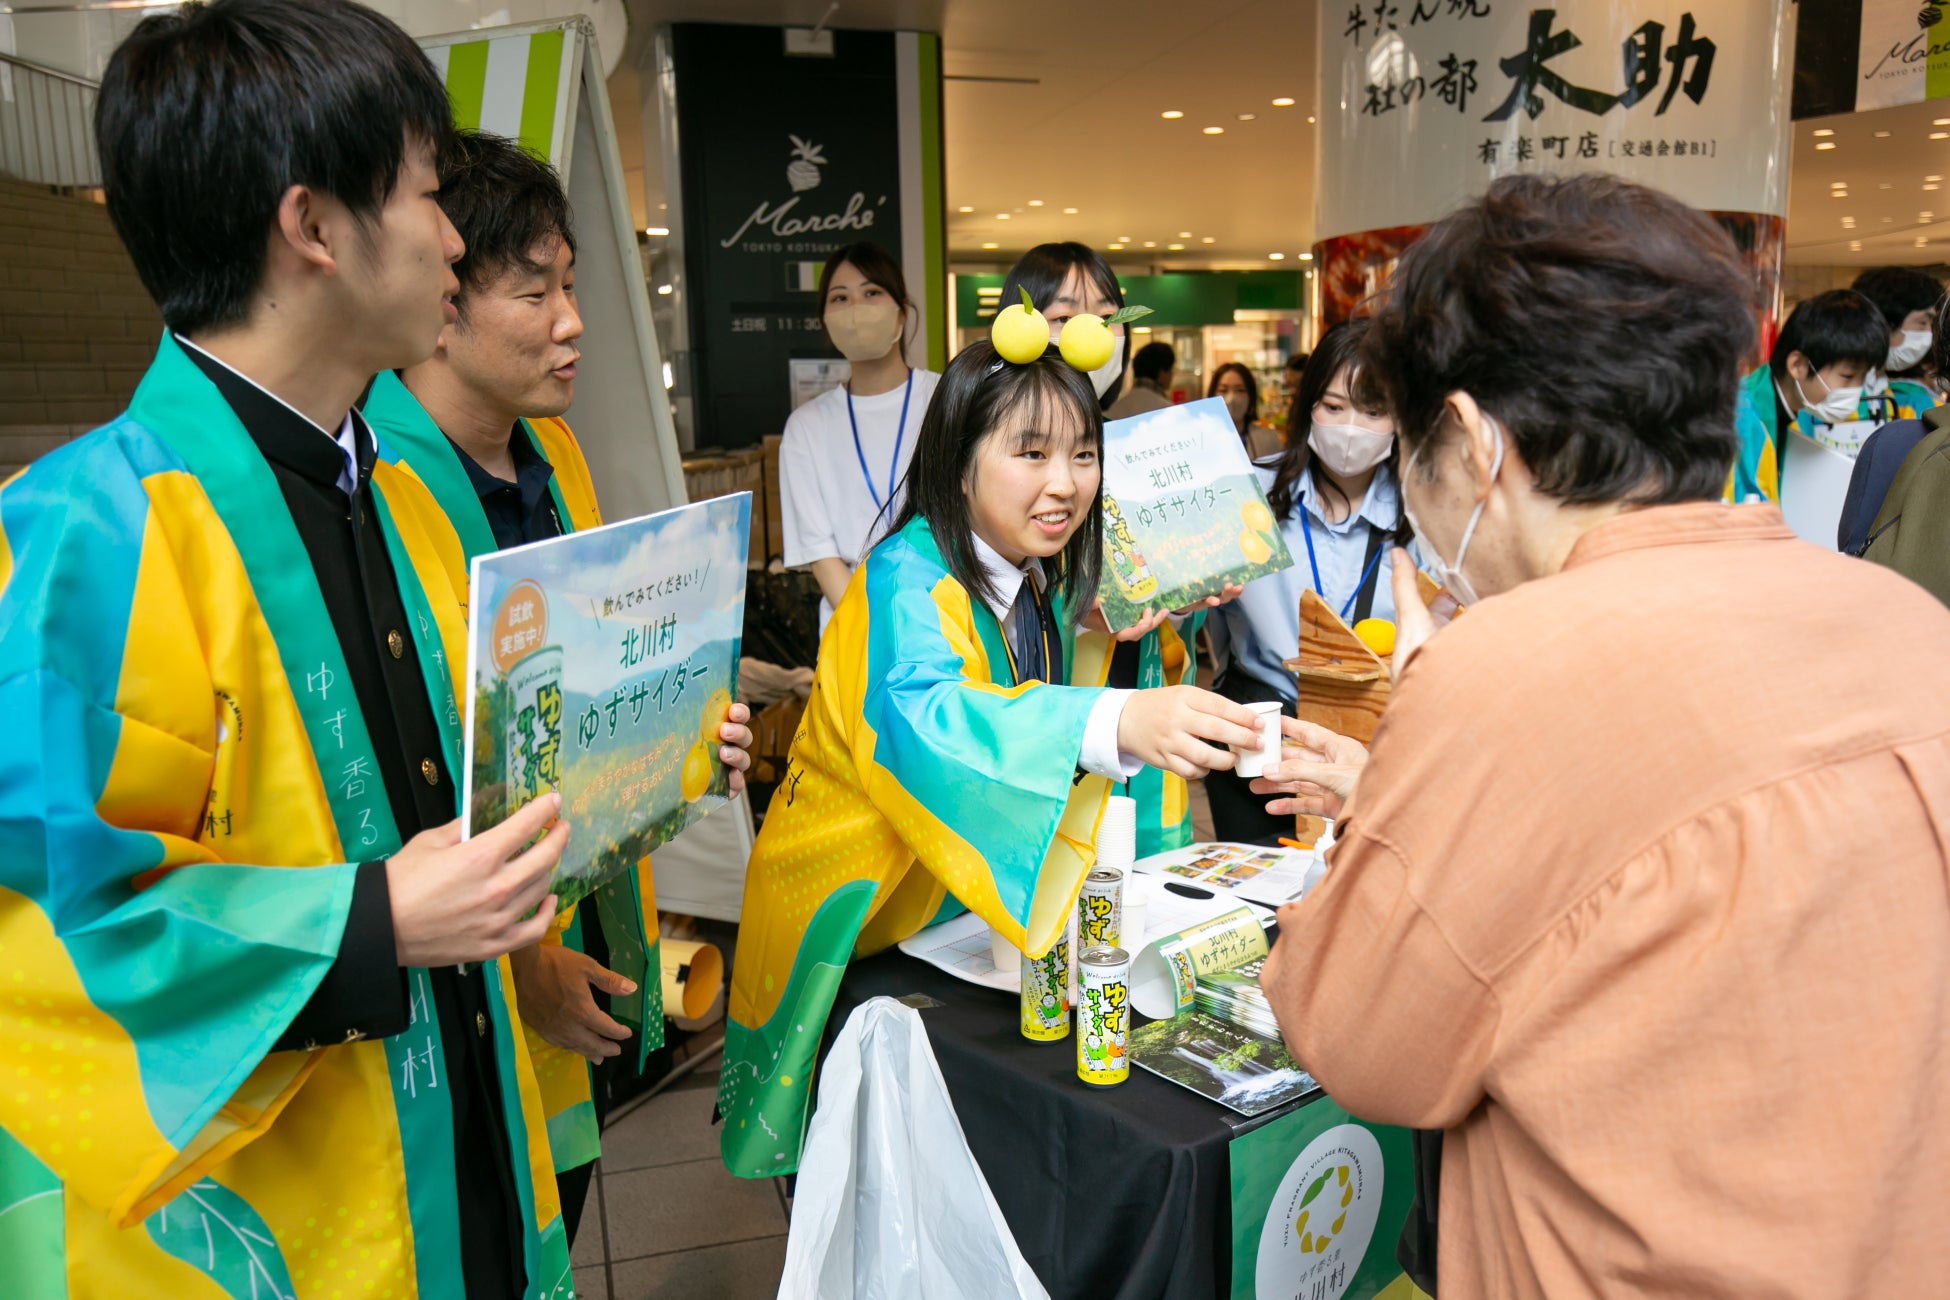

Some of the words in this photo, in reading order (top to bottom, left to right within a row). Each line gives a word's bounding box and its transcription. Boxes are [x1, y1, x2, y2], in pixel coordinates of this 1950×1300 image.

[1361, 52, 1479, 117] 杜の都
[1481, 8, 1718, 122] 太助
[1477, 131, 1600, 164] 有楽町店
[742, 242, 782, 253] TOKYO
[1149, 461, 1193, 489] 北川村
[1136, 486, 1233, 529] ゆずサイダー
[508, 600, 535, 628] 試飲
[619, 612, 678, 669] 北川村
[578, 656, 709, 750] ゆずサイダー
[517, 703, 538, 798] サイダー
[536, 679, 562, 786] ゆず
[1088, 895, 1113, 942] ゆず
[1208, 927, 1239, 947] 北川村
[1200, 936, 1256, 967] ゆずサイダー
[1086, 988, 1104, 1037] サイダー
[1102, 982, 1127, 1034] ゆず
[1310, 1149, 1337, 1170] VILLAGE
